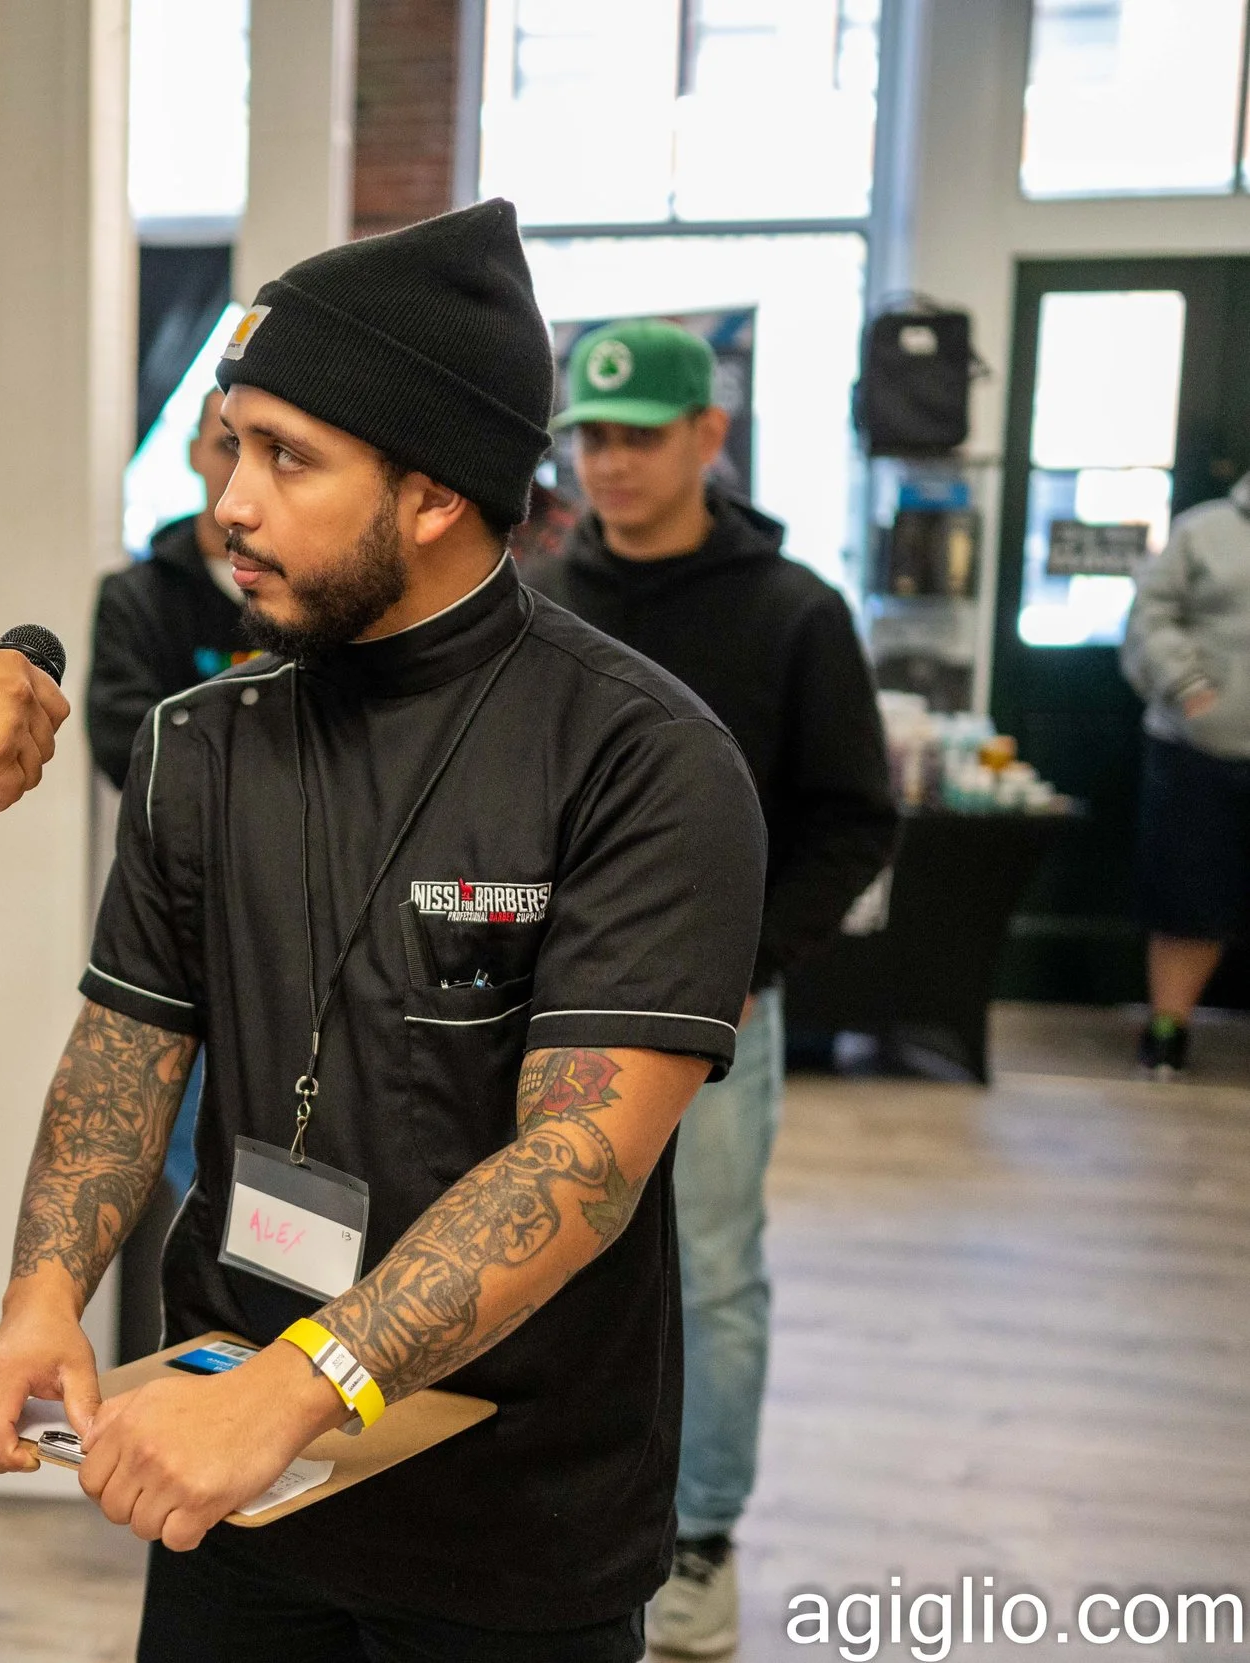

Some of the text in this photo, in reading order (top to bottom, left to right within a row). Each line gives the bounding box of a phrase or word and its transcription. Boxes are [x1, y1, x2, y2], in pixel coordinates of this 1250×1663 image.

[414, 884, 549, 913] NISSI FOR BARBERS
[447, 911, 488, 922] PROFESSIONAL
[489, 911, 515, 923] BARBER
[249, 1207, 307, 1253] ALEX
[341, 1230, 352, 1241] 13
